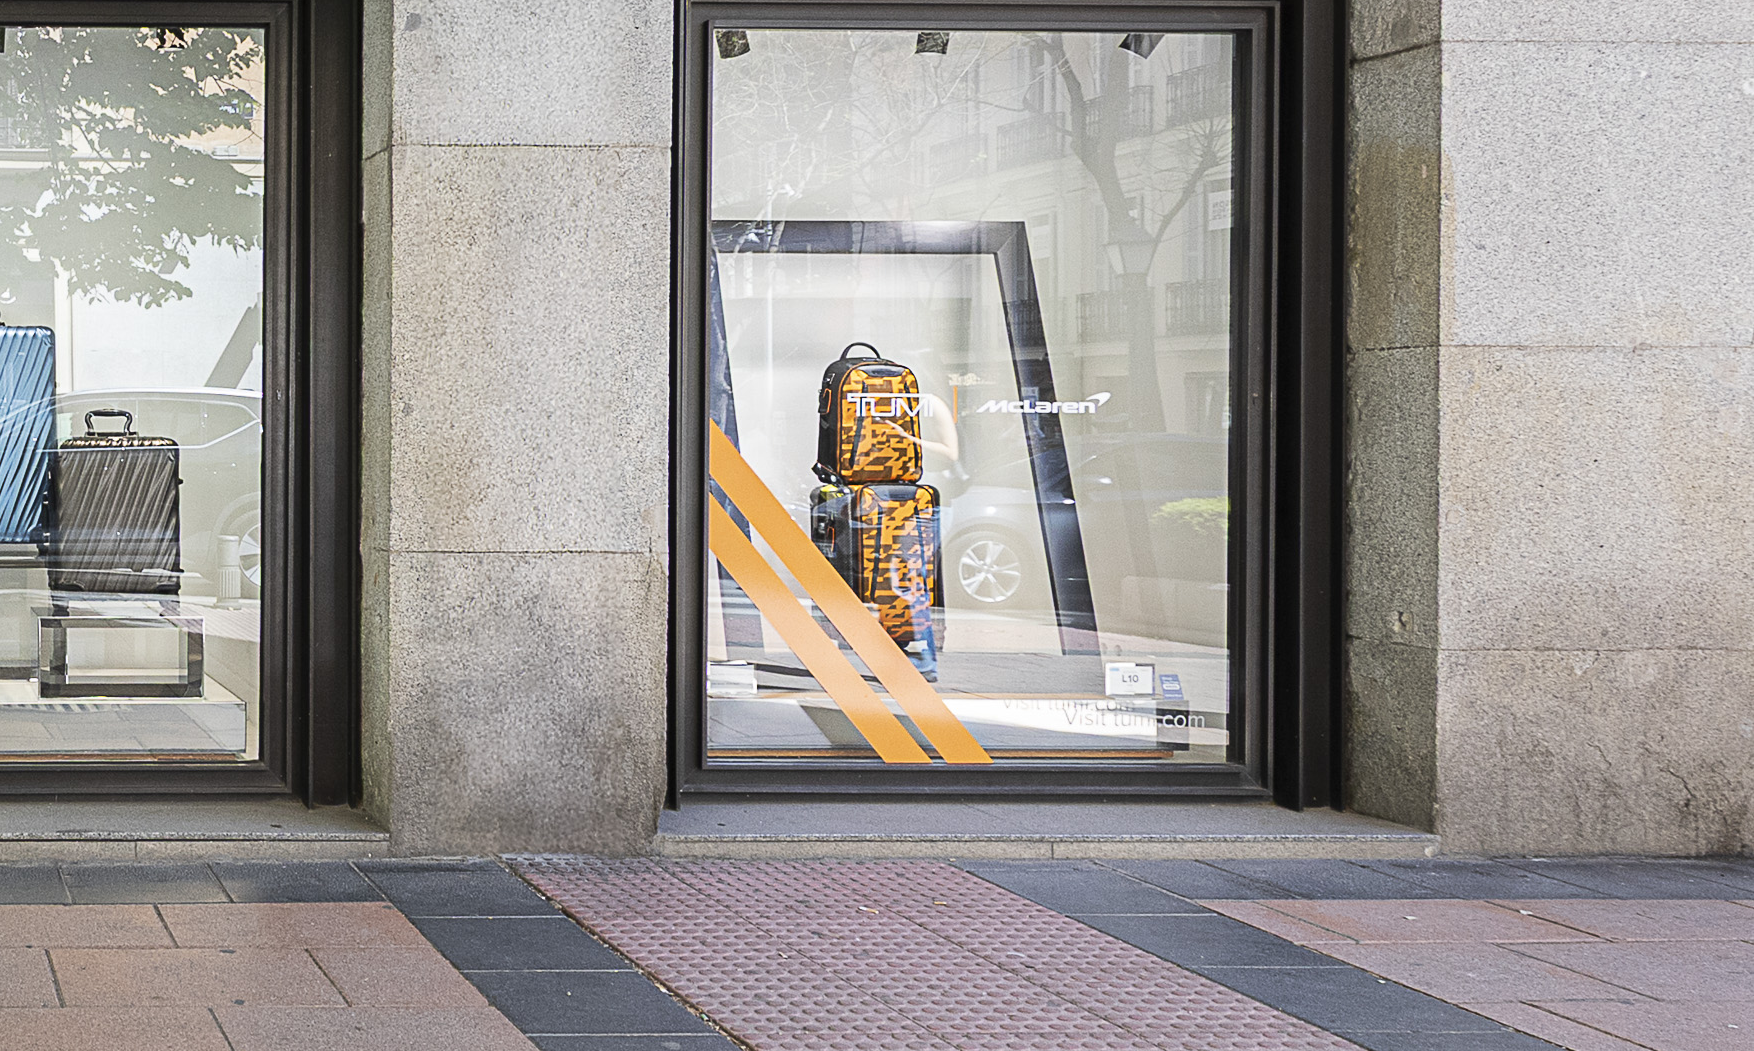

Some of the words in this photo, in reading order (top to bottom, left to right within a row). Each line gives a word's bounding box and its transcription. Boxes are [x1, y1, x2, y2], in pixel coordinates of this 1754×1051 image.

[847, 392, 935, 418] TUMI
[976, 398, 1096, 414] McLaren
[1061, 706, 1106, 727] Visit
[1114, 711, 1206, 729] tumi.com
